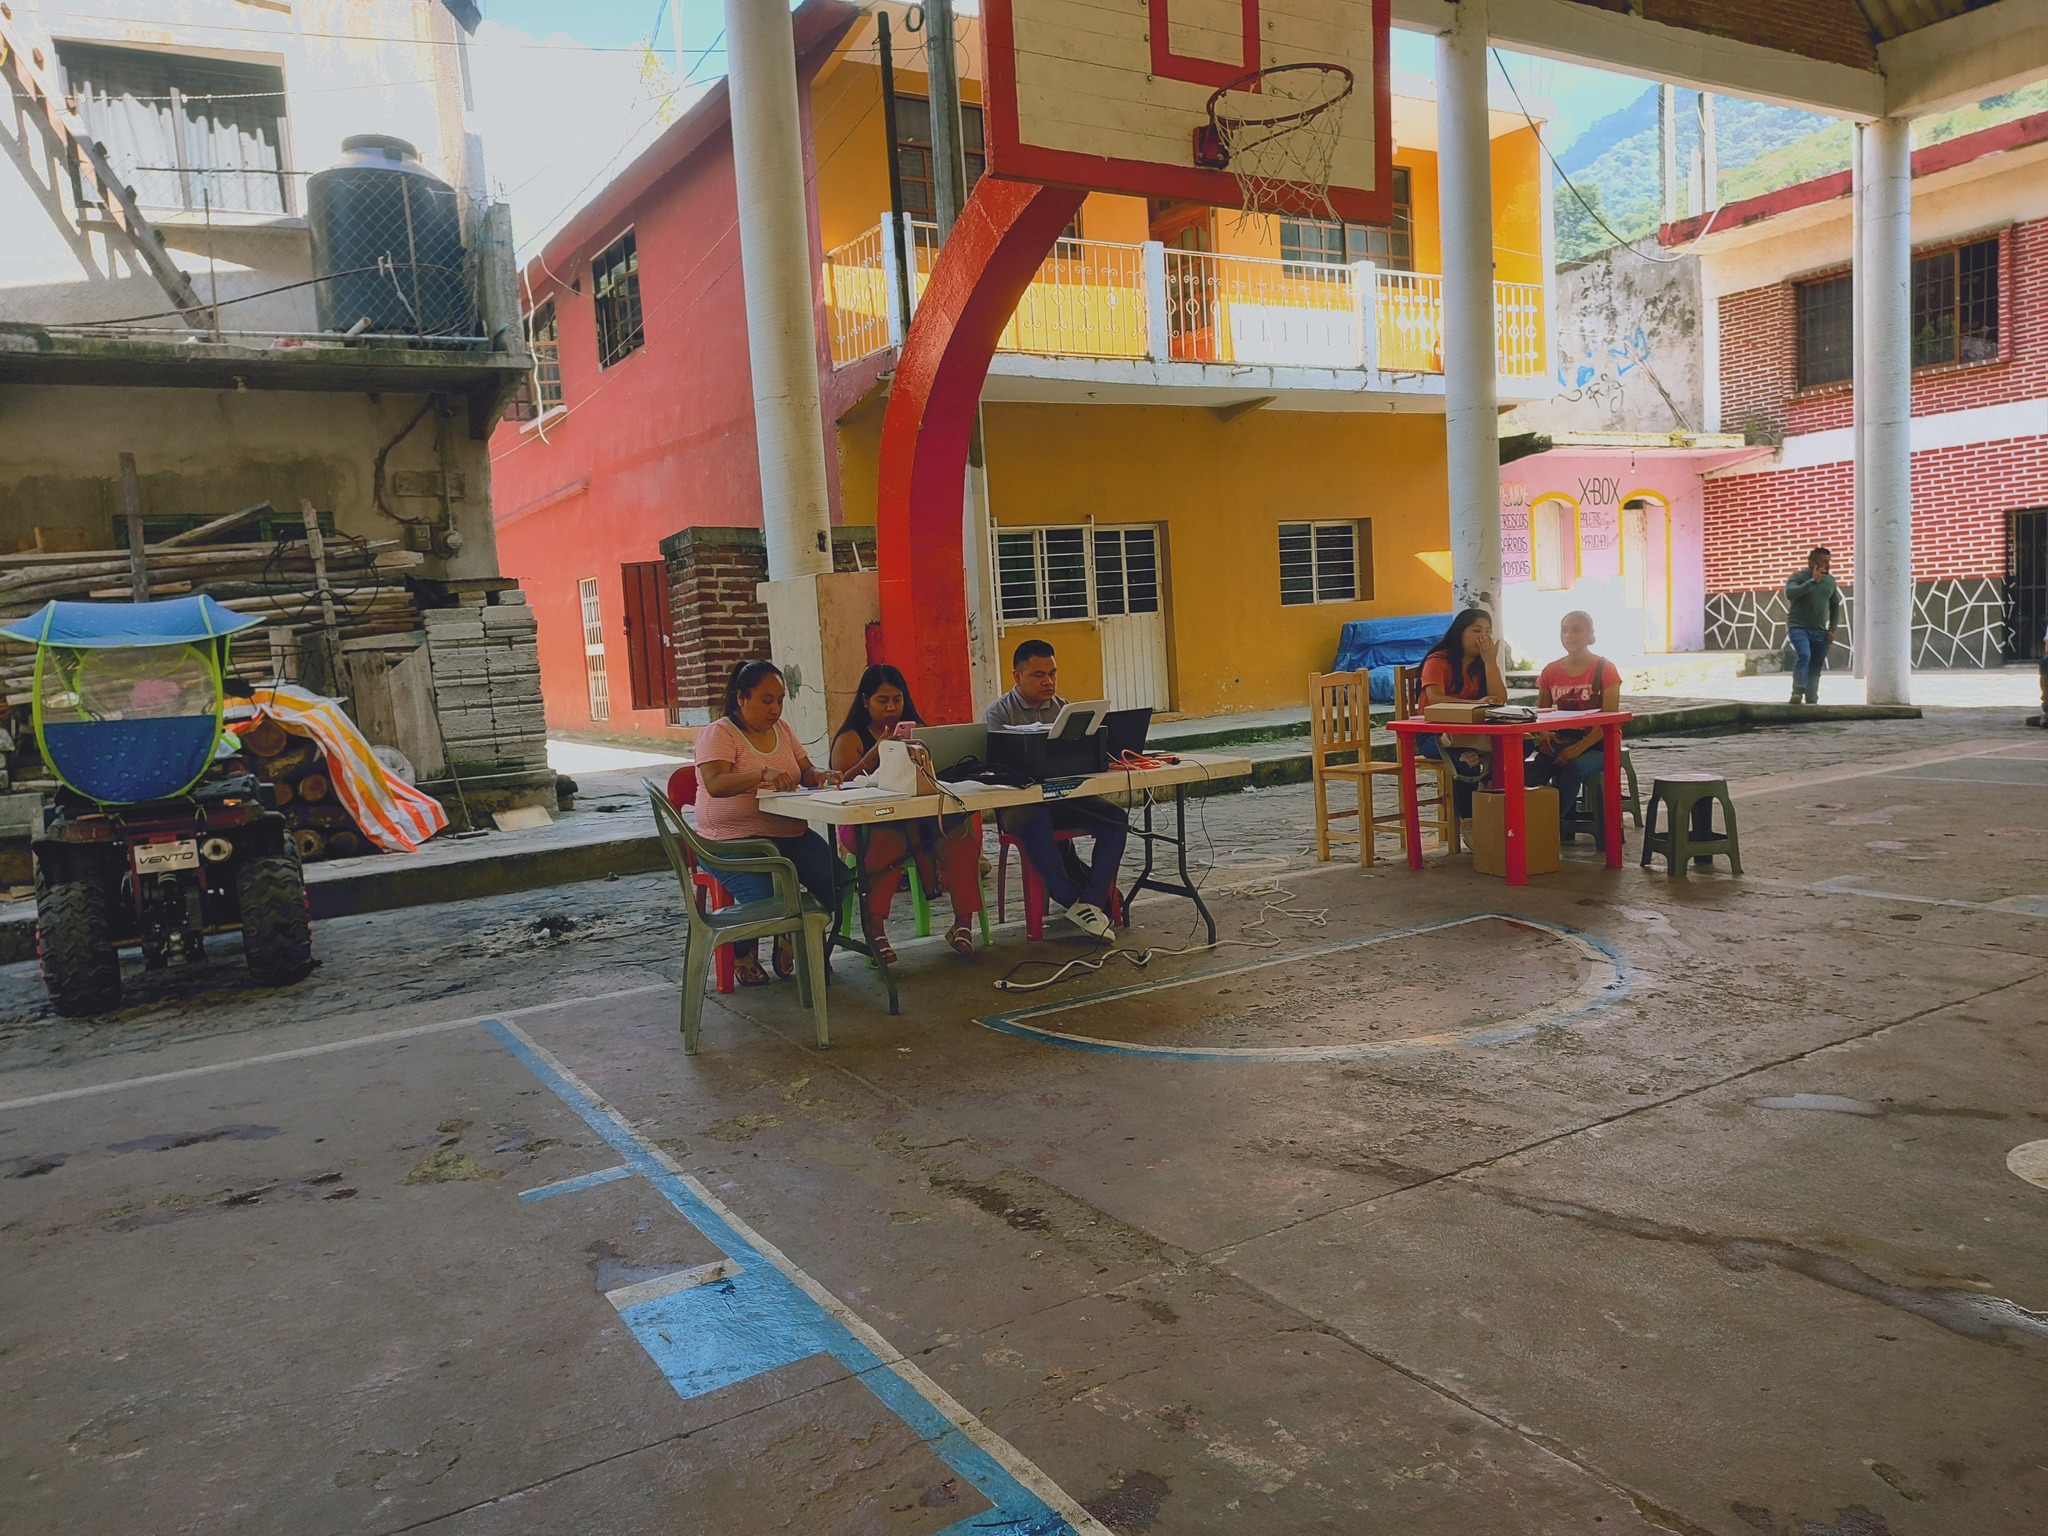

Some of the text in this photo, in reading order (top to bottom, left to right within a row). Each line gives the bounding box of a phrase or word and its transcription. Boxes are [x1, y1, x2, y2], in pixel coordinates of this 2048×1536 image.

[1500, 482, 1532, 507] ENDE
[1501, 537, 1528, 551] ARROS
[139, 852, 194, 865] VENTO
